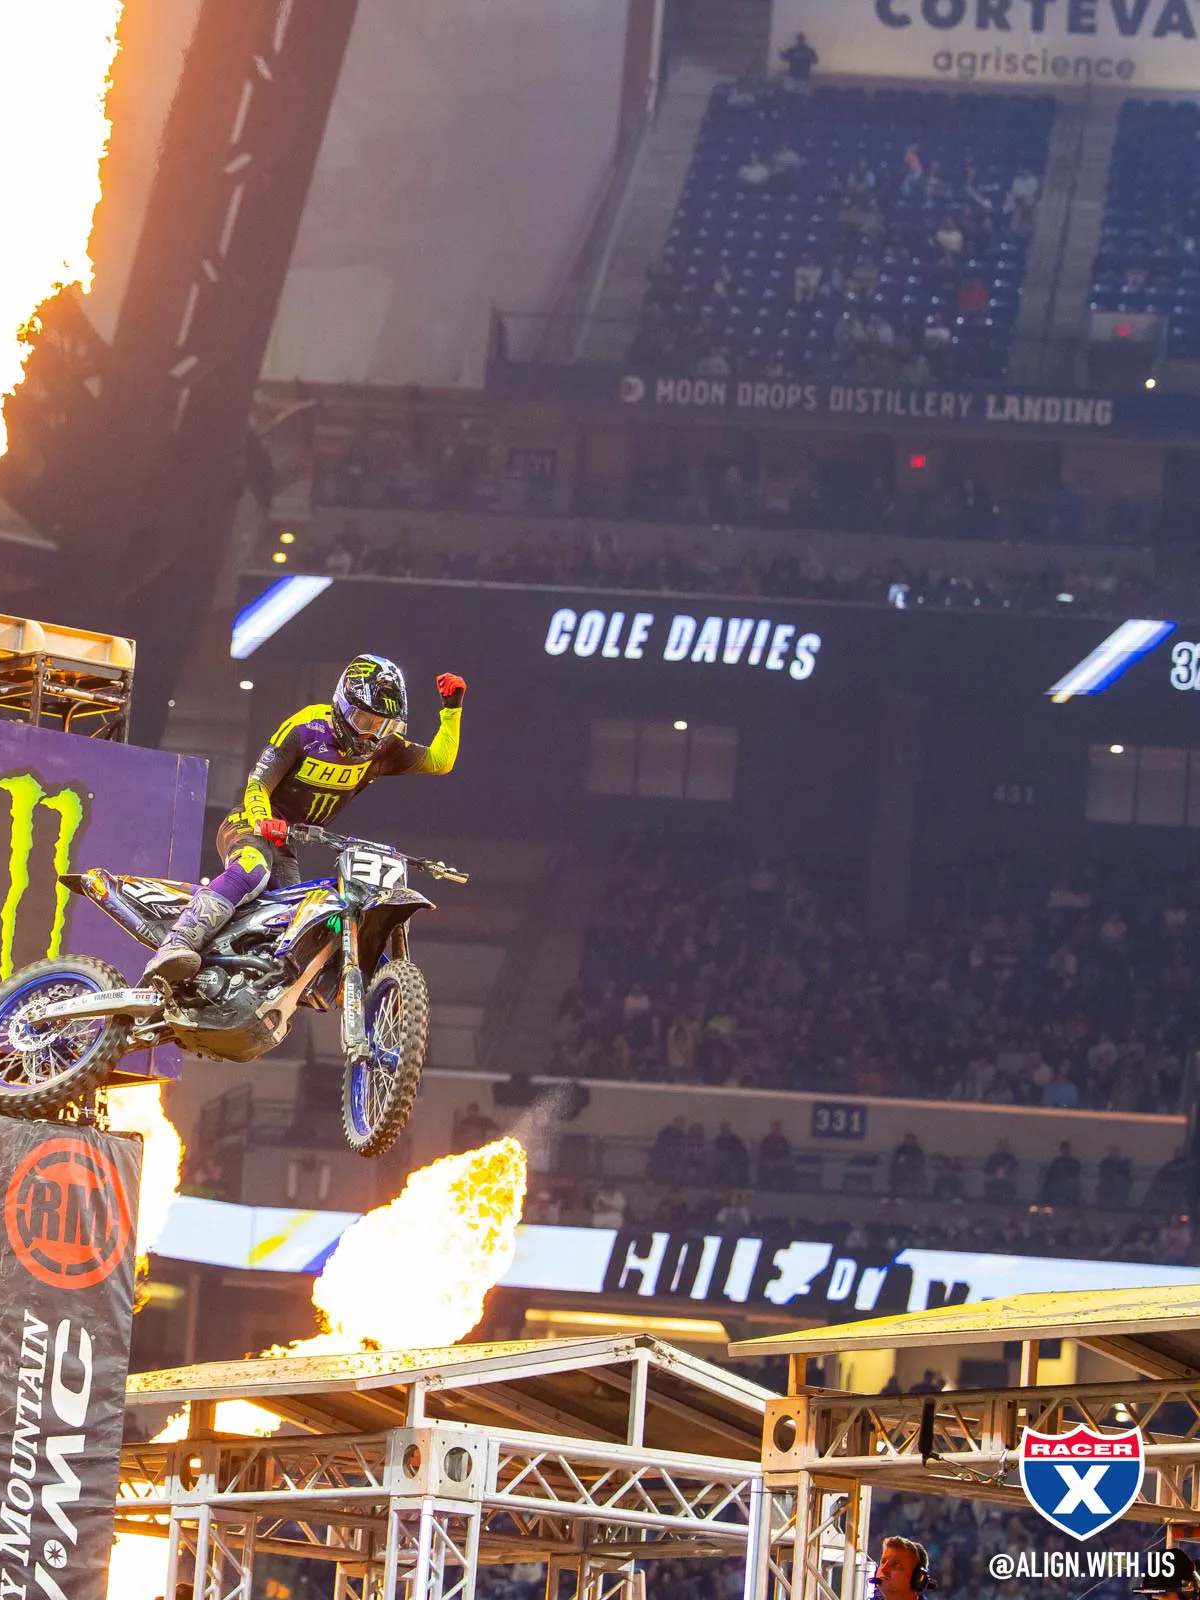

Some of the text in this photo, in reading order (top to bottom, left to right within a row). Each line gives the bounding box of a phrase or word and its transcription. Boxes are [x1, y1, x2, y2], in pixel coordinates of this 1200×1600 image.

[873, 0, 1198, 39] CORTEVA
[932, 47, 1136, 82] agriscience
[656, 379, 1113, 427] MOON DROPS DISTILLERY LANDING
[544, 608, 821, 681] COLE DAVIES
[1170, 641, 1200, 691] 3
[351, 849, 405, 890] 37
[347, 981, 356, 1029] DUNLOP
[815, 1108, 860, 1132] 331
